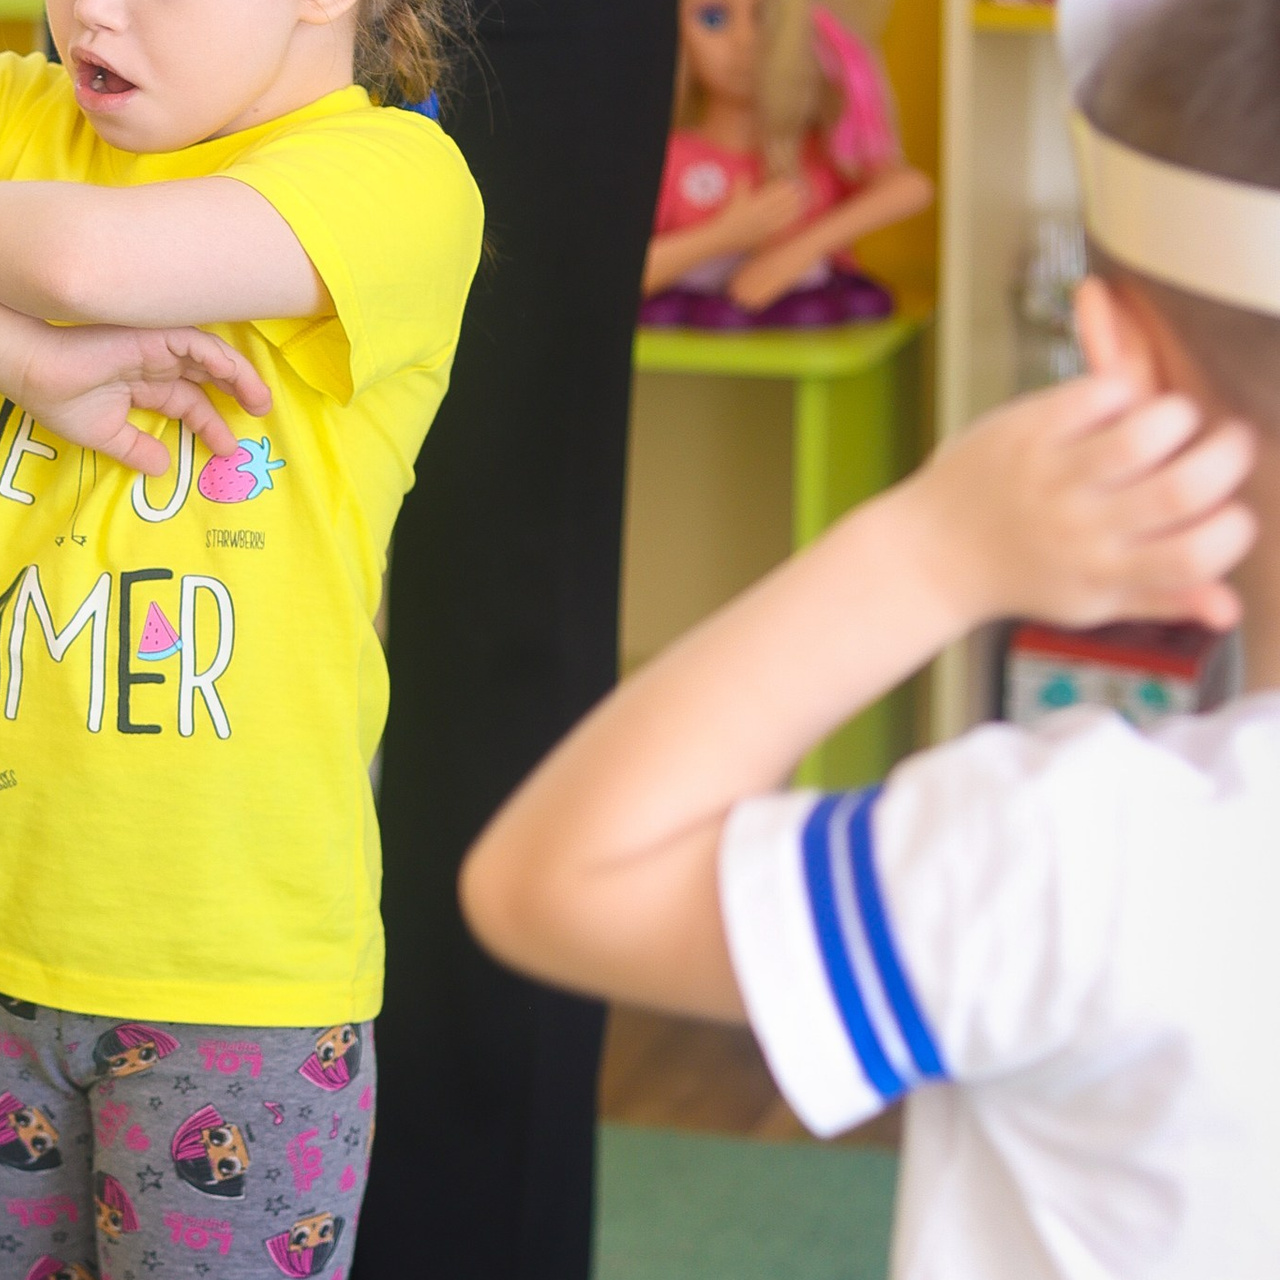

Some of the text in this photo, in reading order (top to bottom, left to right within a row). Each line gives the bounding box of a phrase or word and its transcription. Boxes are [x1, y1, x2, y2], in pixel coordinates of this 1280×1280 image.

[198, 1042, 263, 1079] LOL
[294, 1127, 324, 1192] LOL
[7, 1198, 78, 1229] LOL
[163, 1217, 233, 1255] LOL
